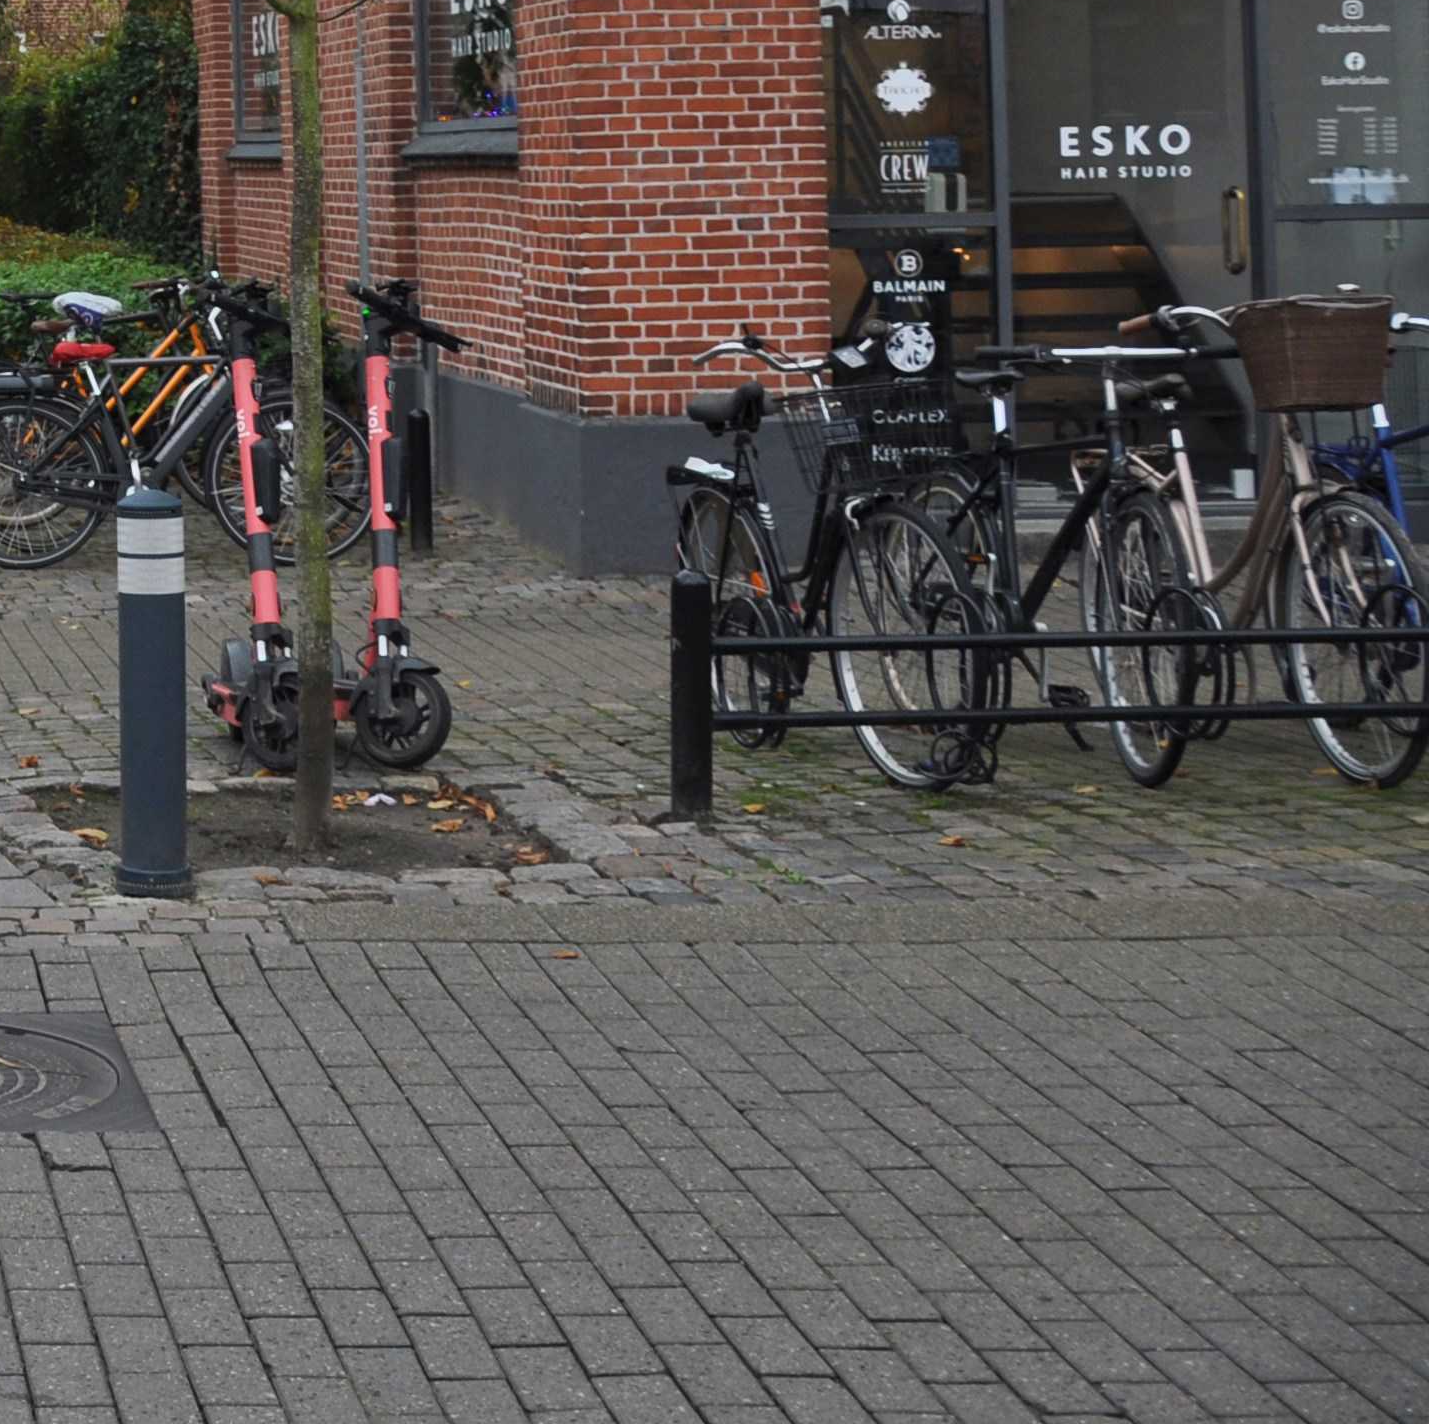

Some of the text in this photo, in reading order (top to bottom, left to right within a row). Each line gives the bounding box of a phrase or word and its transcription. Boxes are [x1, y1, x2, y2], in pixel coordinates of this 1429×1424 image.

[252, 11, 279, 56] ESK
[452, 28, 512, 57] HAIR STUDIO
[863, 24, 934, 40] ALTERNA
[1059, 124, 1191, 157] ESKO
[880, 154, 930, 181] CREW
[1061, 165, 1192, 179] HAIR STUDIO
[901, 255, 917, 272] B
[873, 280, 945, 293] BALMAIN
[895, 295, 924, 303] PARIS
[236, 408, 251, 444] voi.
[368, 405, 383, 440] voi.
